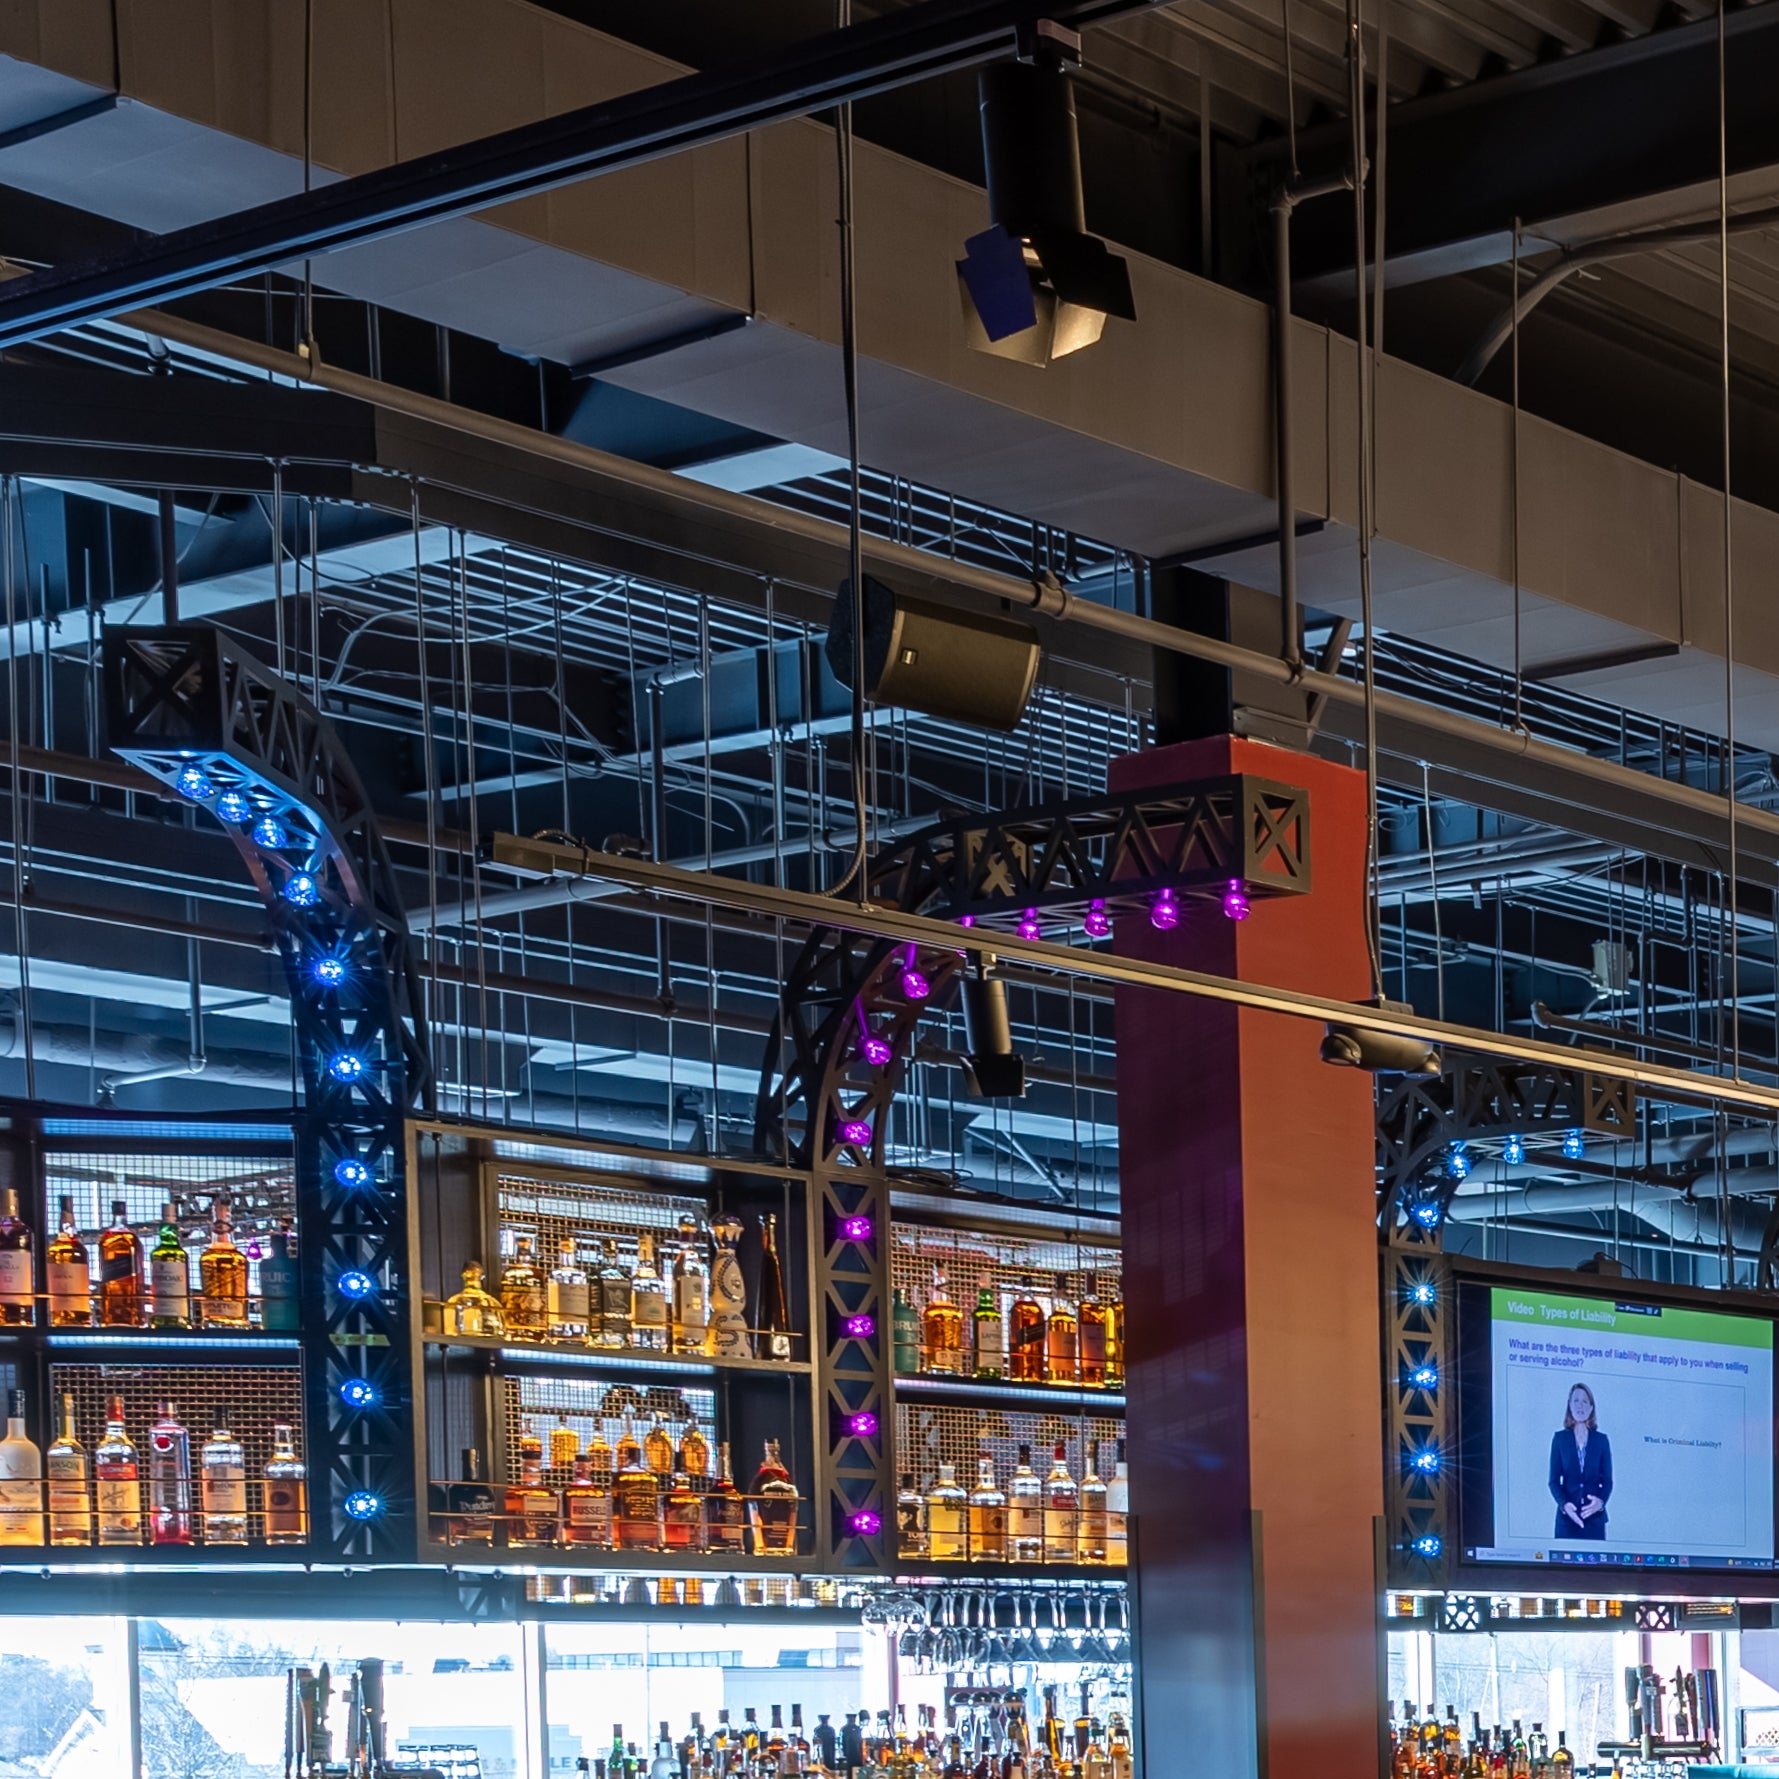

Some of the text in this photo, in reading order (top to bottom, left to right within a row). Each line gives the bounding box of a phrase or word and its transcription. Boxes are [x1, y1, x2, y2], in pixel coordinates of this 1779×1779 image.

[1507, 1301, 1616, 1327] Video Types of Liability
[1509, 1338, 1748, 1374] What are the three types of liability that apply to you when selling
[1509, 1353, 1584, 1368] or serving alcohol?
